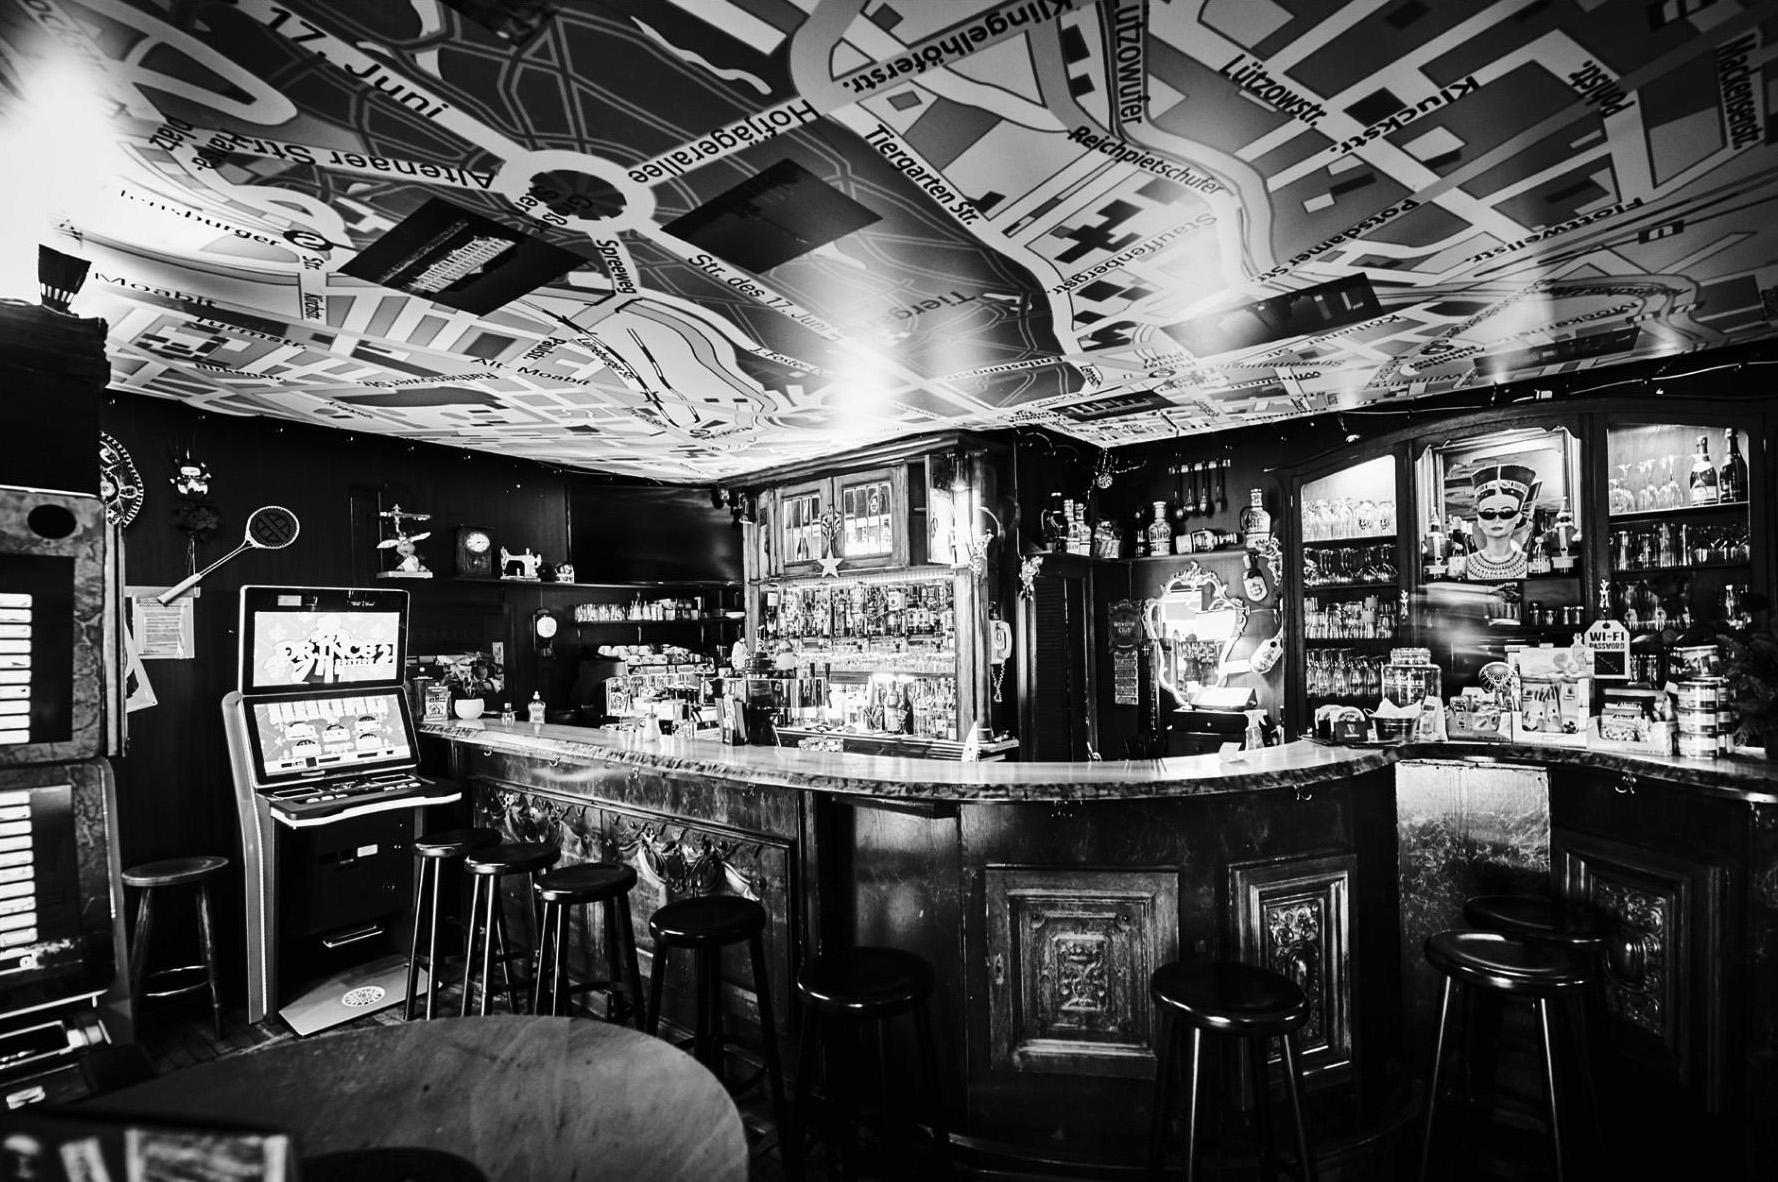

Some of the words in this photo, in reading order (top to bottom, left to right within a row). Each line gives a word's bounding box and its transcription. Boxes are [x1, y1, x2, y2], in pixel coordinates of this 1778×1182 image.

[267, 6, 327, 58] 17.
[344, 61, 449, 119] Juni
[1218, 54, 1328, 127] Lützowstr.
[1570, 59, 1634, 118] Pohlstr.
[627, 98, 822, 185] Hofjägerallee
[1329, 76, 1480, 154] Kluckstr.
[864, 124, 954, 207] Tiergarten
[949, 197, 983, 225] Str.
[1069, 126, 1226, 195] Reichpietschufer
[1046, 212, 1218, 295] Stauffenbergstr.
[1288, 198, 1420, 266] Potsdamer
[1466, 197, 1645, 263] Flottwellstr.
[95, 272, 216, 307] Moabit
[597, 239, 636, 295] Spreeweg
[688, 254, 725, 281] Str.
[727, 270, 766, 297] des
[198, 315, 306, 350] Turmstr.
[517, 366, 591, 386] Moabit
[1589, 631, 1625, 641] WI-FI
